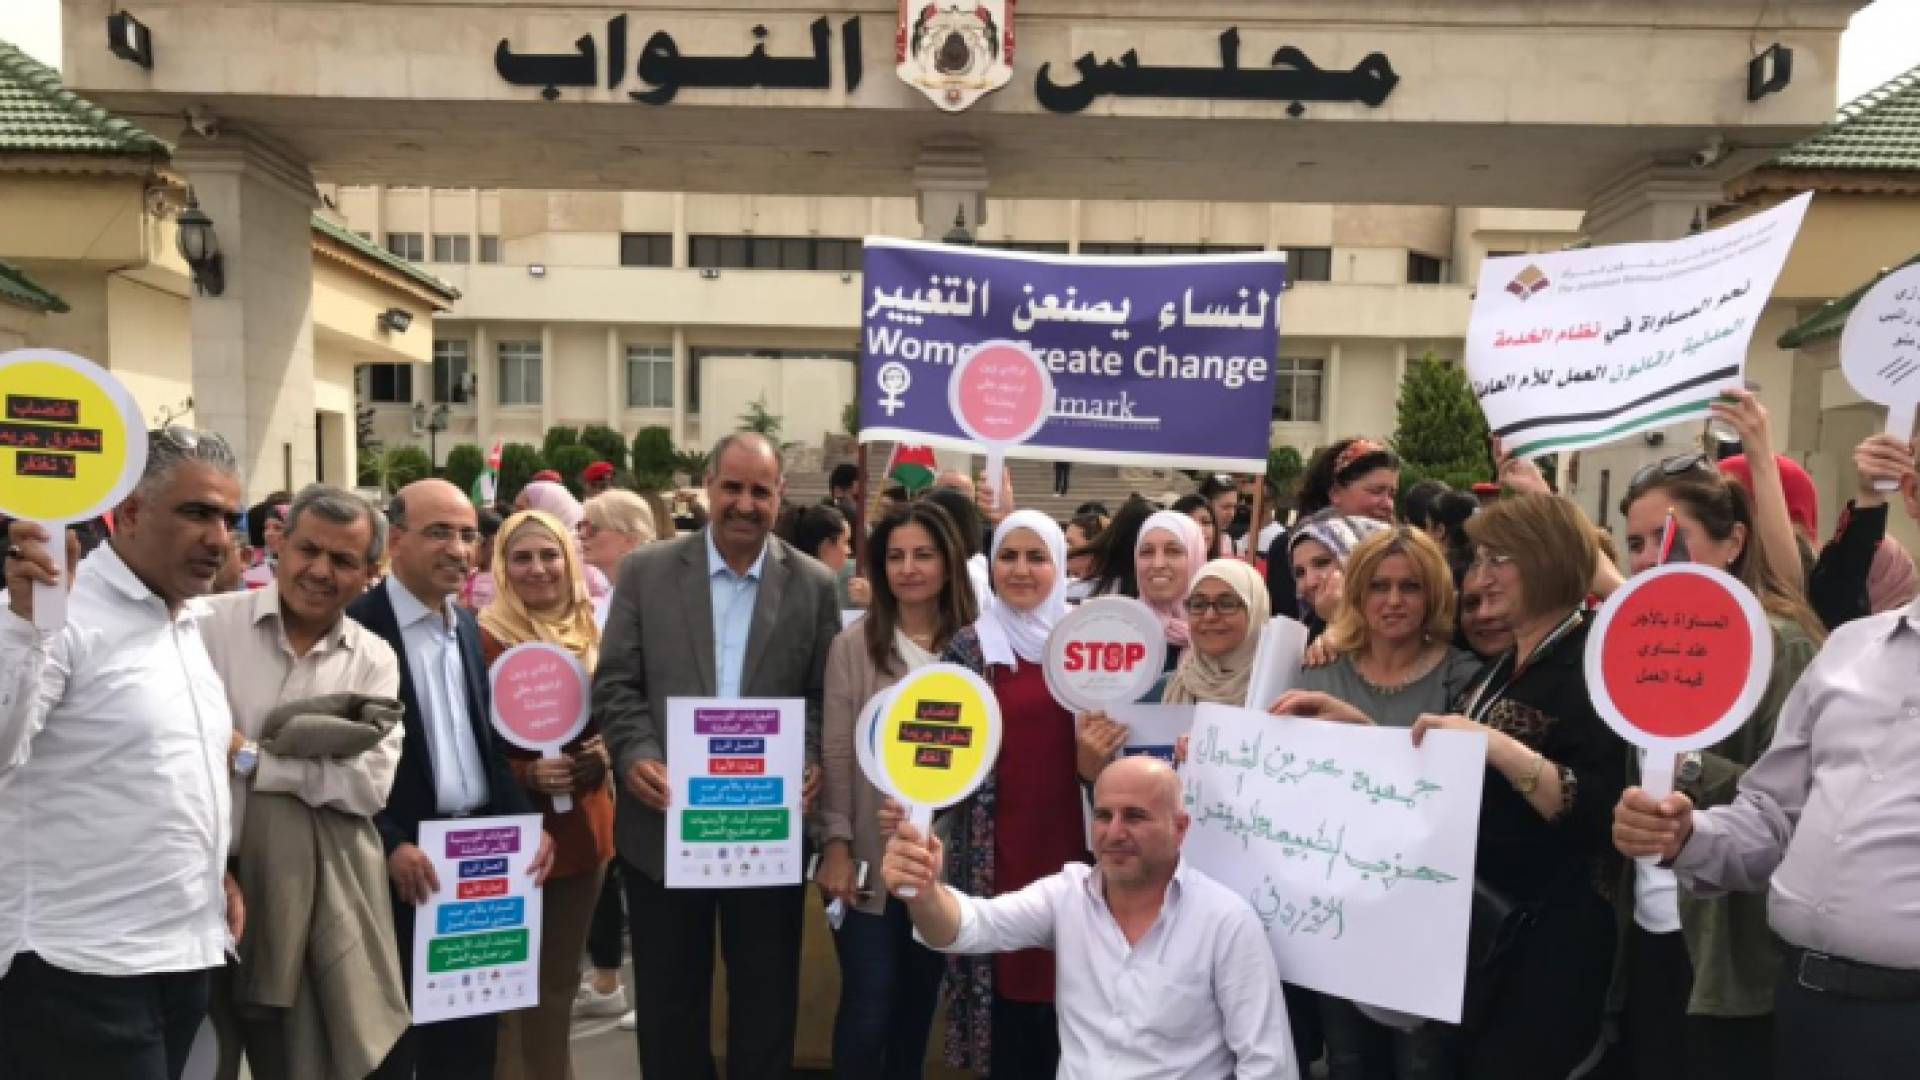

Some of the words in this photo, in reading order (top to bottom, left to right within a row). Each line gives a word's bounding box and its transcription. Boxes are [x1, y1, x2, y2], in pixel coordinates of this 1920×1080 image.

[496, 15, 861, 105] النواب
[1036, 26, 1400, 116] مجلس
[866, 275, 989, 324] التغيير
[1012, 283, 1130, 341] يصنعن
[1158, 286, 1281, 332] النساء
[1603, 316, 1632, 345] في
[1134, 346, 1268, 389] Change
[1556, 364, 1607, 388] العمل
[1675, 611, 1728, 631] المساواة
[1064, 639, 1146, 672] STOP
[1636, 668, 1669, 684] العمل
[1674, 668, 1705, 687] قيمة
